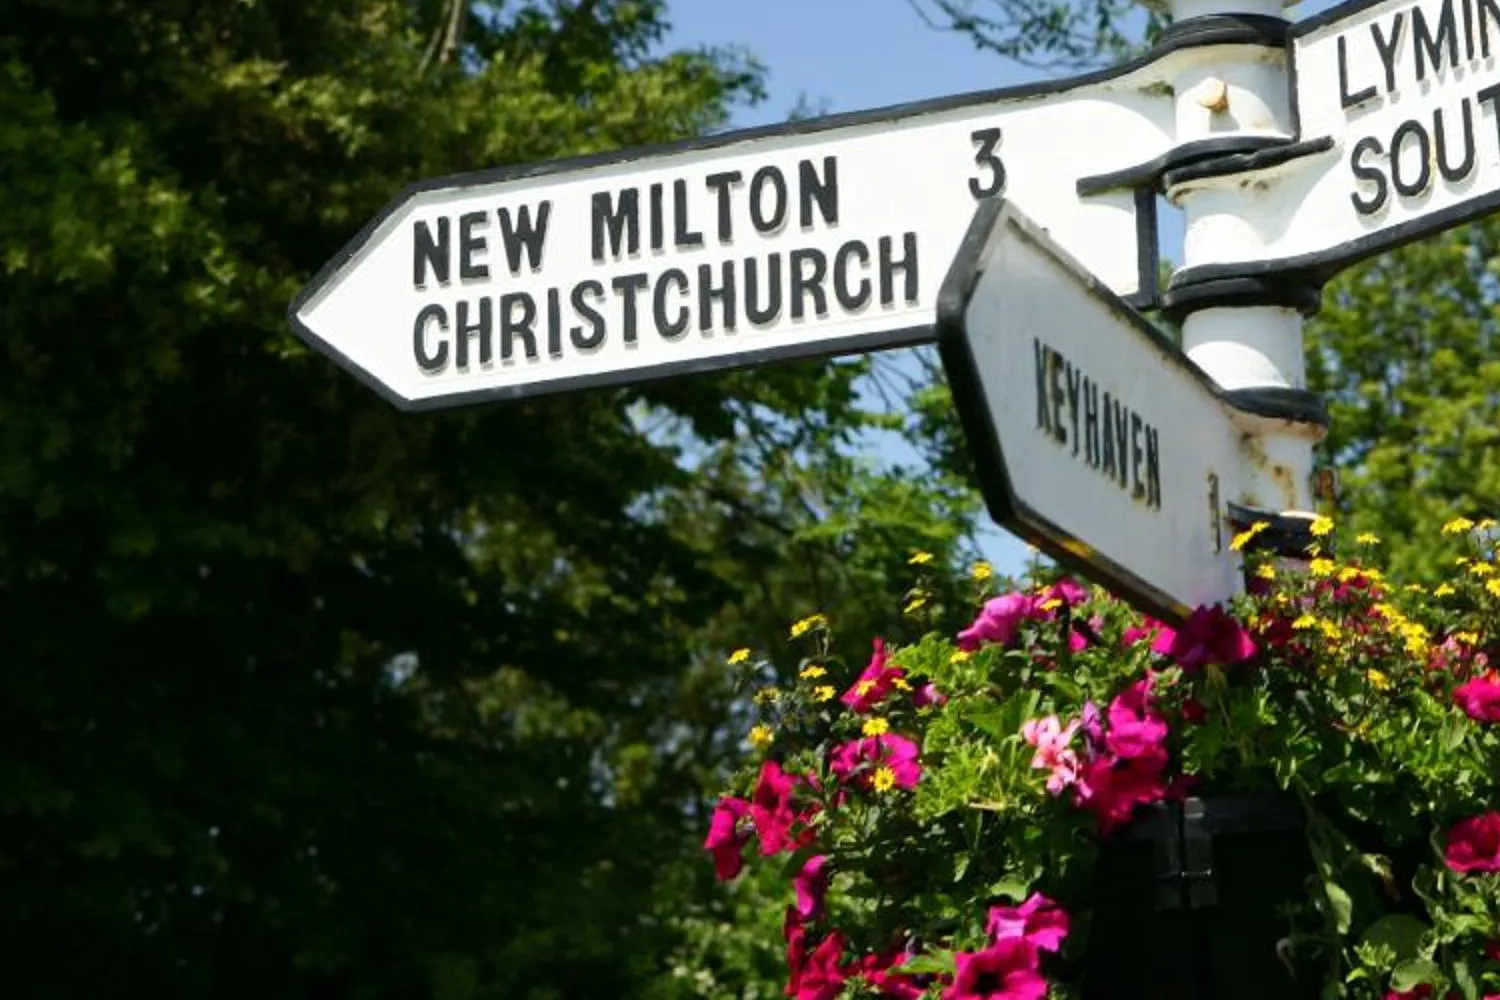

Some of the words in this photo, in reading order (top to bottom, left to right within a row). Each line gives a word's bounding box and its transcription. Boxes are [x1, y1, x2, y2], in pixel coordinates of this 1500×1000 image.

[413, 200, 551, 287] NEW
[592, 155, 838, 262] MILTON
[968, 127, 1007, 199] 3
[413, 231, 919, 373] CHRISTCHURCH
[1034, 336, 1161, 511] KEYHAVEN
